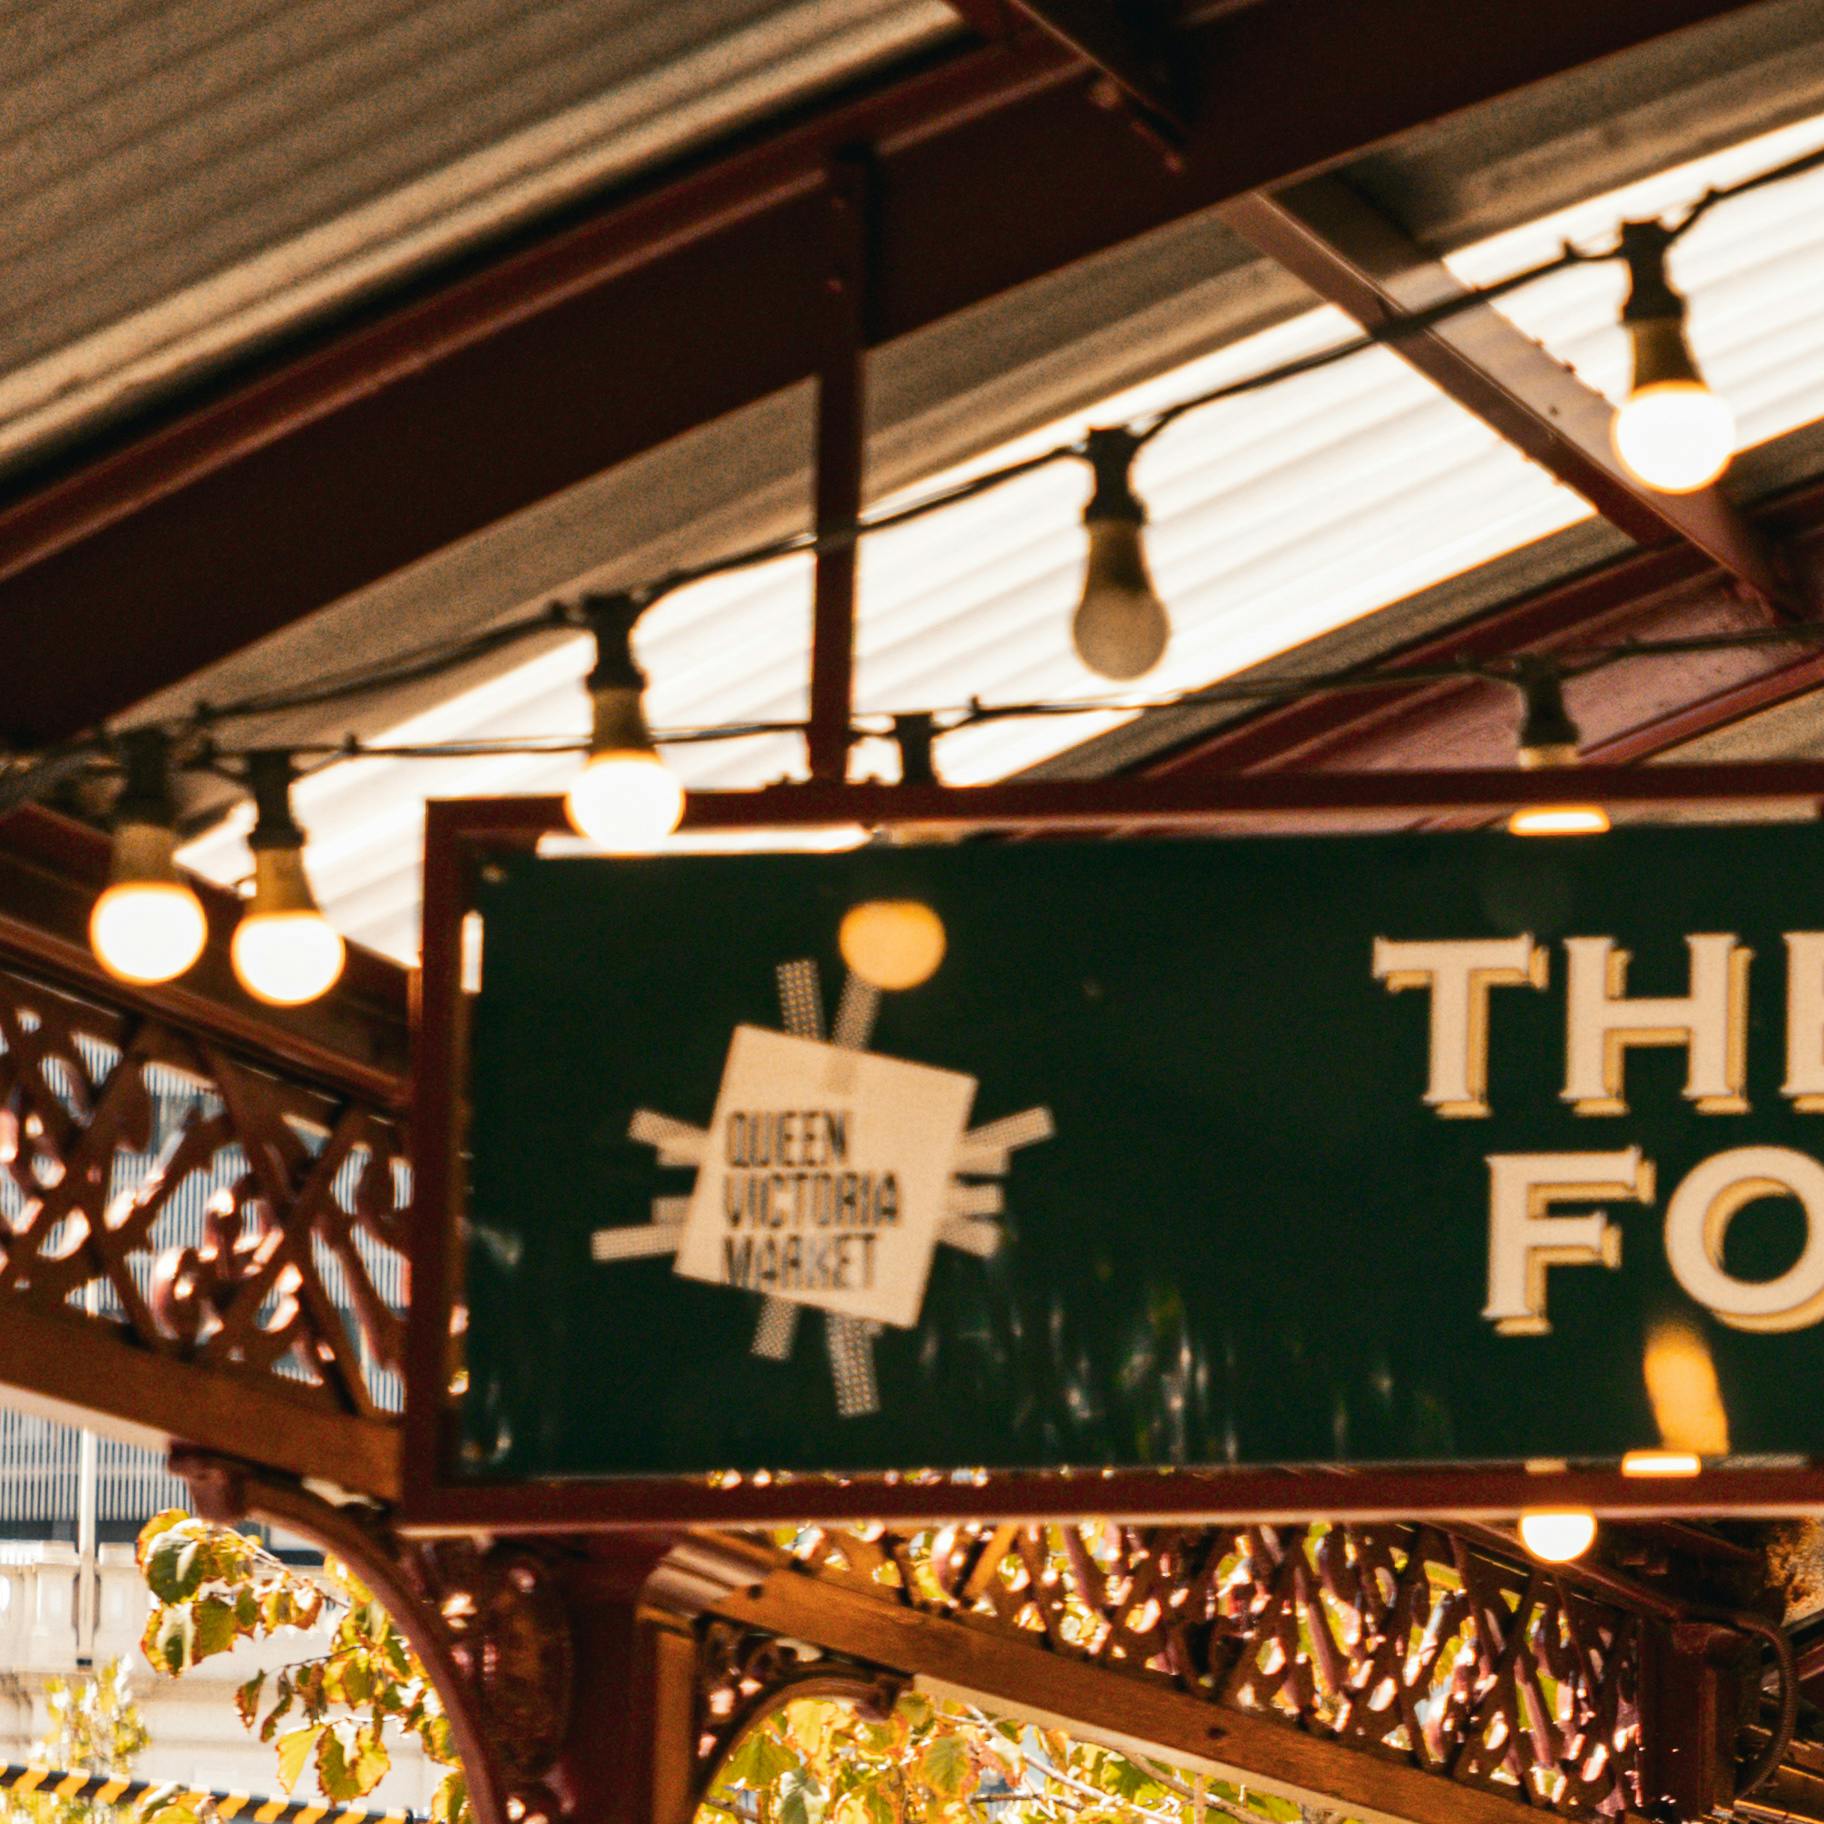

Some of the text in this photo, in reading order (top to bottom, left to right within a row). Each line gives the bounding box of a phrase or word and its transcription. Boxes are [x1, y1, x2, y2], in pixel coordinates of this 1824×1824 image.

[725, 1108, 853, 1168] QUEEN
[722, 1169, 902, 1230] VICTORIA
[723, 1232, 878, 1291] MARKET
